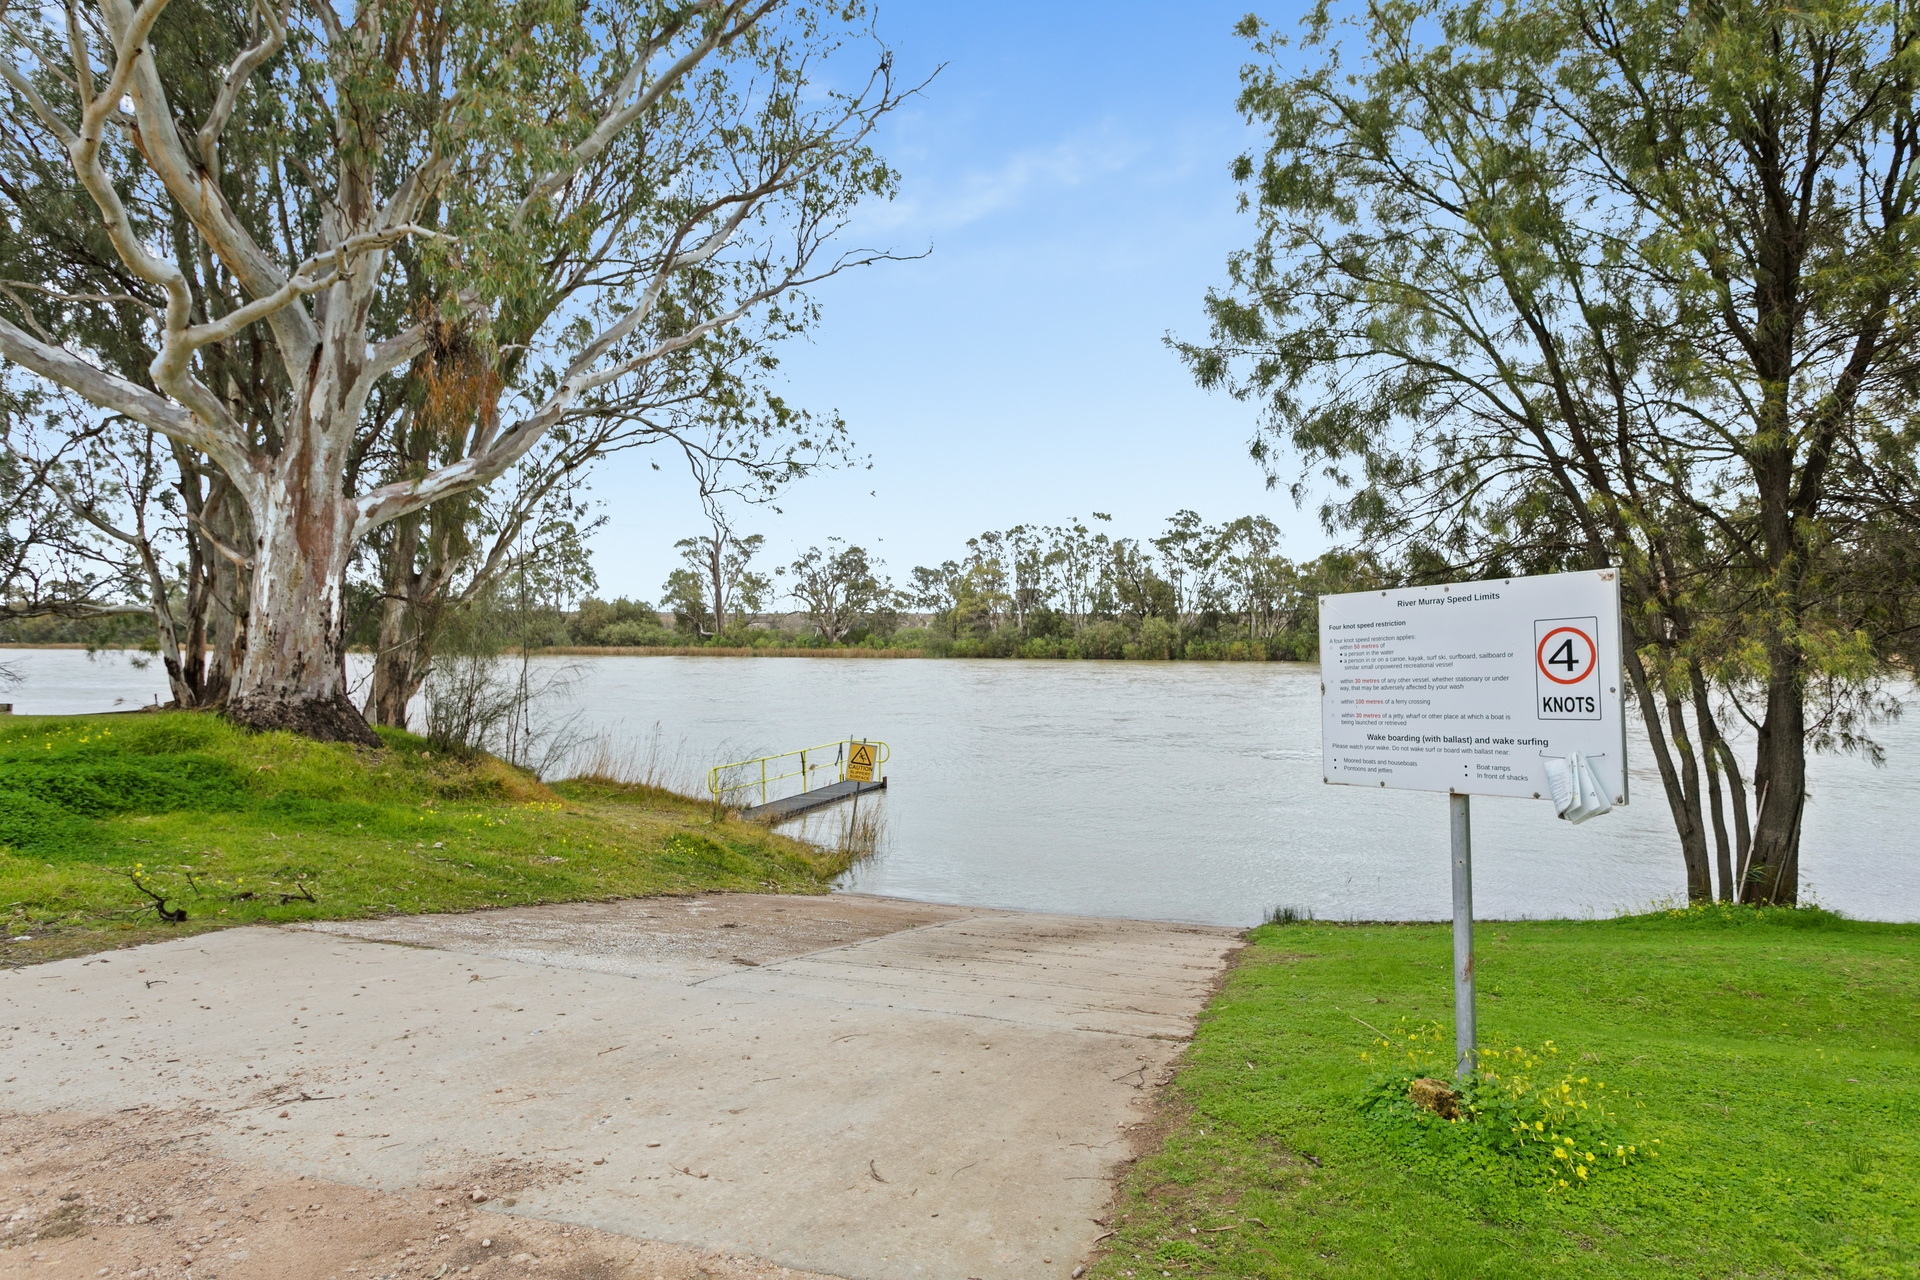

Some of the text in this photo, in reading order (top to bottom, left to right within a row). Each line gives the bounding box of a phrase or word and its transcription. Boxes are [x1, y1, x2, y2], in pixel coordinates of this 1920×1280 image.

[1447, 594, 1471, 604] Speed
[1474, 592, 1500, 601] Limits
[1549, 639, 1579, 671] 4
[1543, 697, 1595, 713] KNOTS
[1388, 734, 1420, 743] boarding
[1423, 735, 1441, 743] (with
[1443, 736, 1472, 745] ballast)
[1517, 738, 1548, 747] surfing
[848, 764, 873, 772] CAUTION
